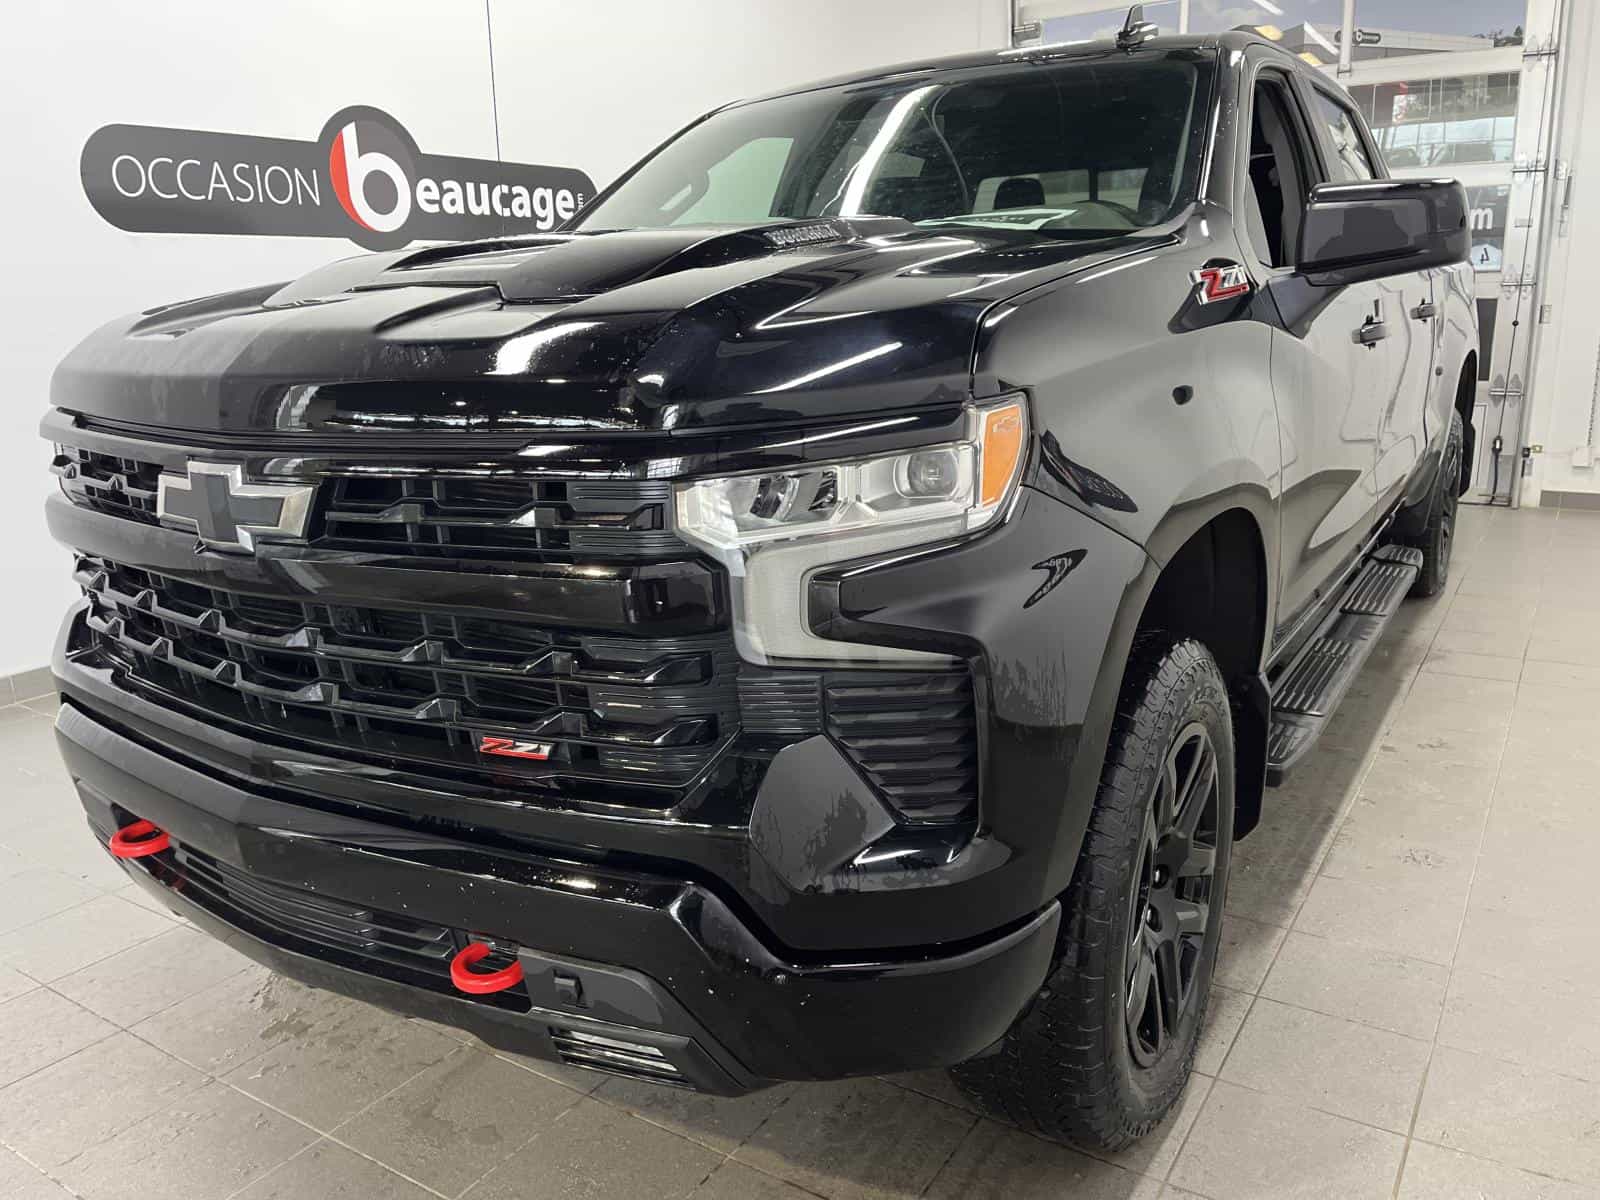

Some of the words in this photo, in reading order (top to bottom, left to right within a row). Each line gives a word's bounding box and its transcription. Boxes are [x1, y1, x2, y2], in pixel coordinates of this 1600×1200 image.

[111, 154, 321, 206] OCCASION
[341, 120, 575, 233] beaucage
[480, 736, 553, 760] Z71
